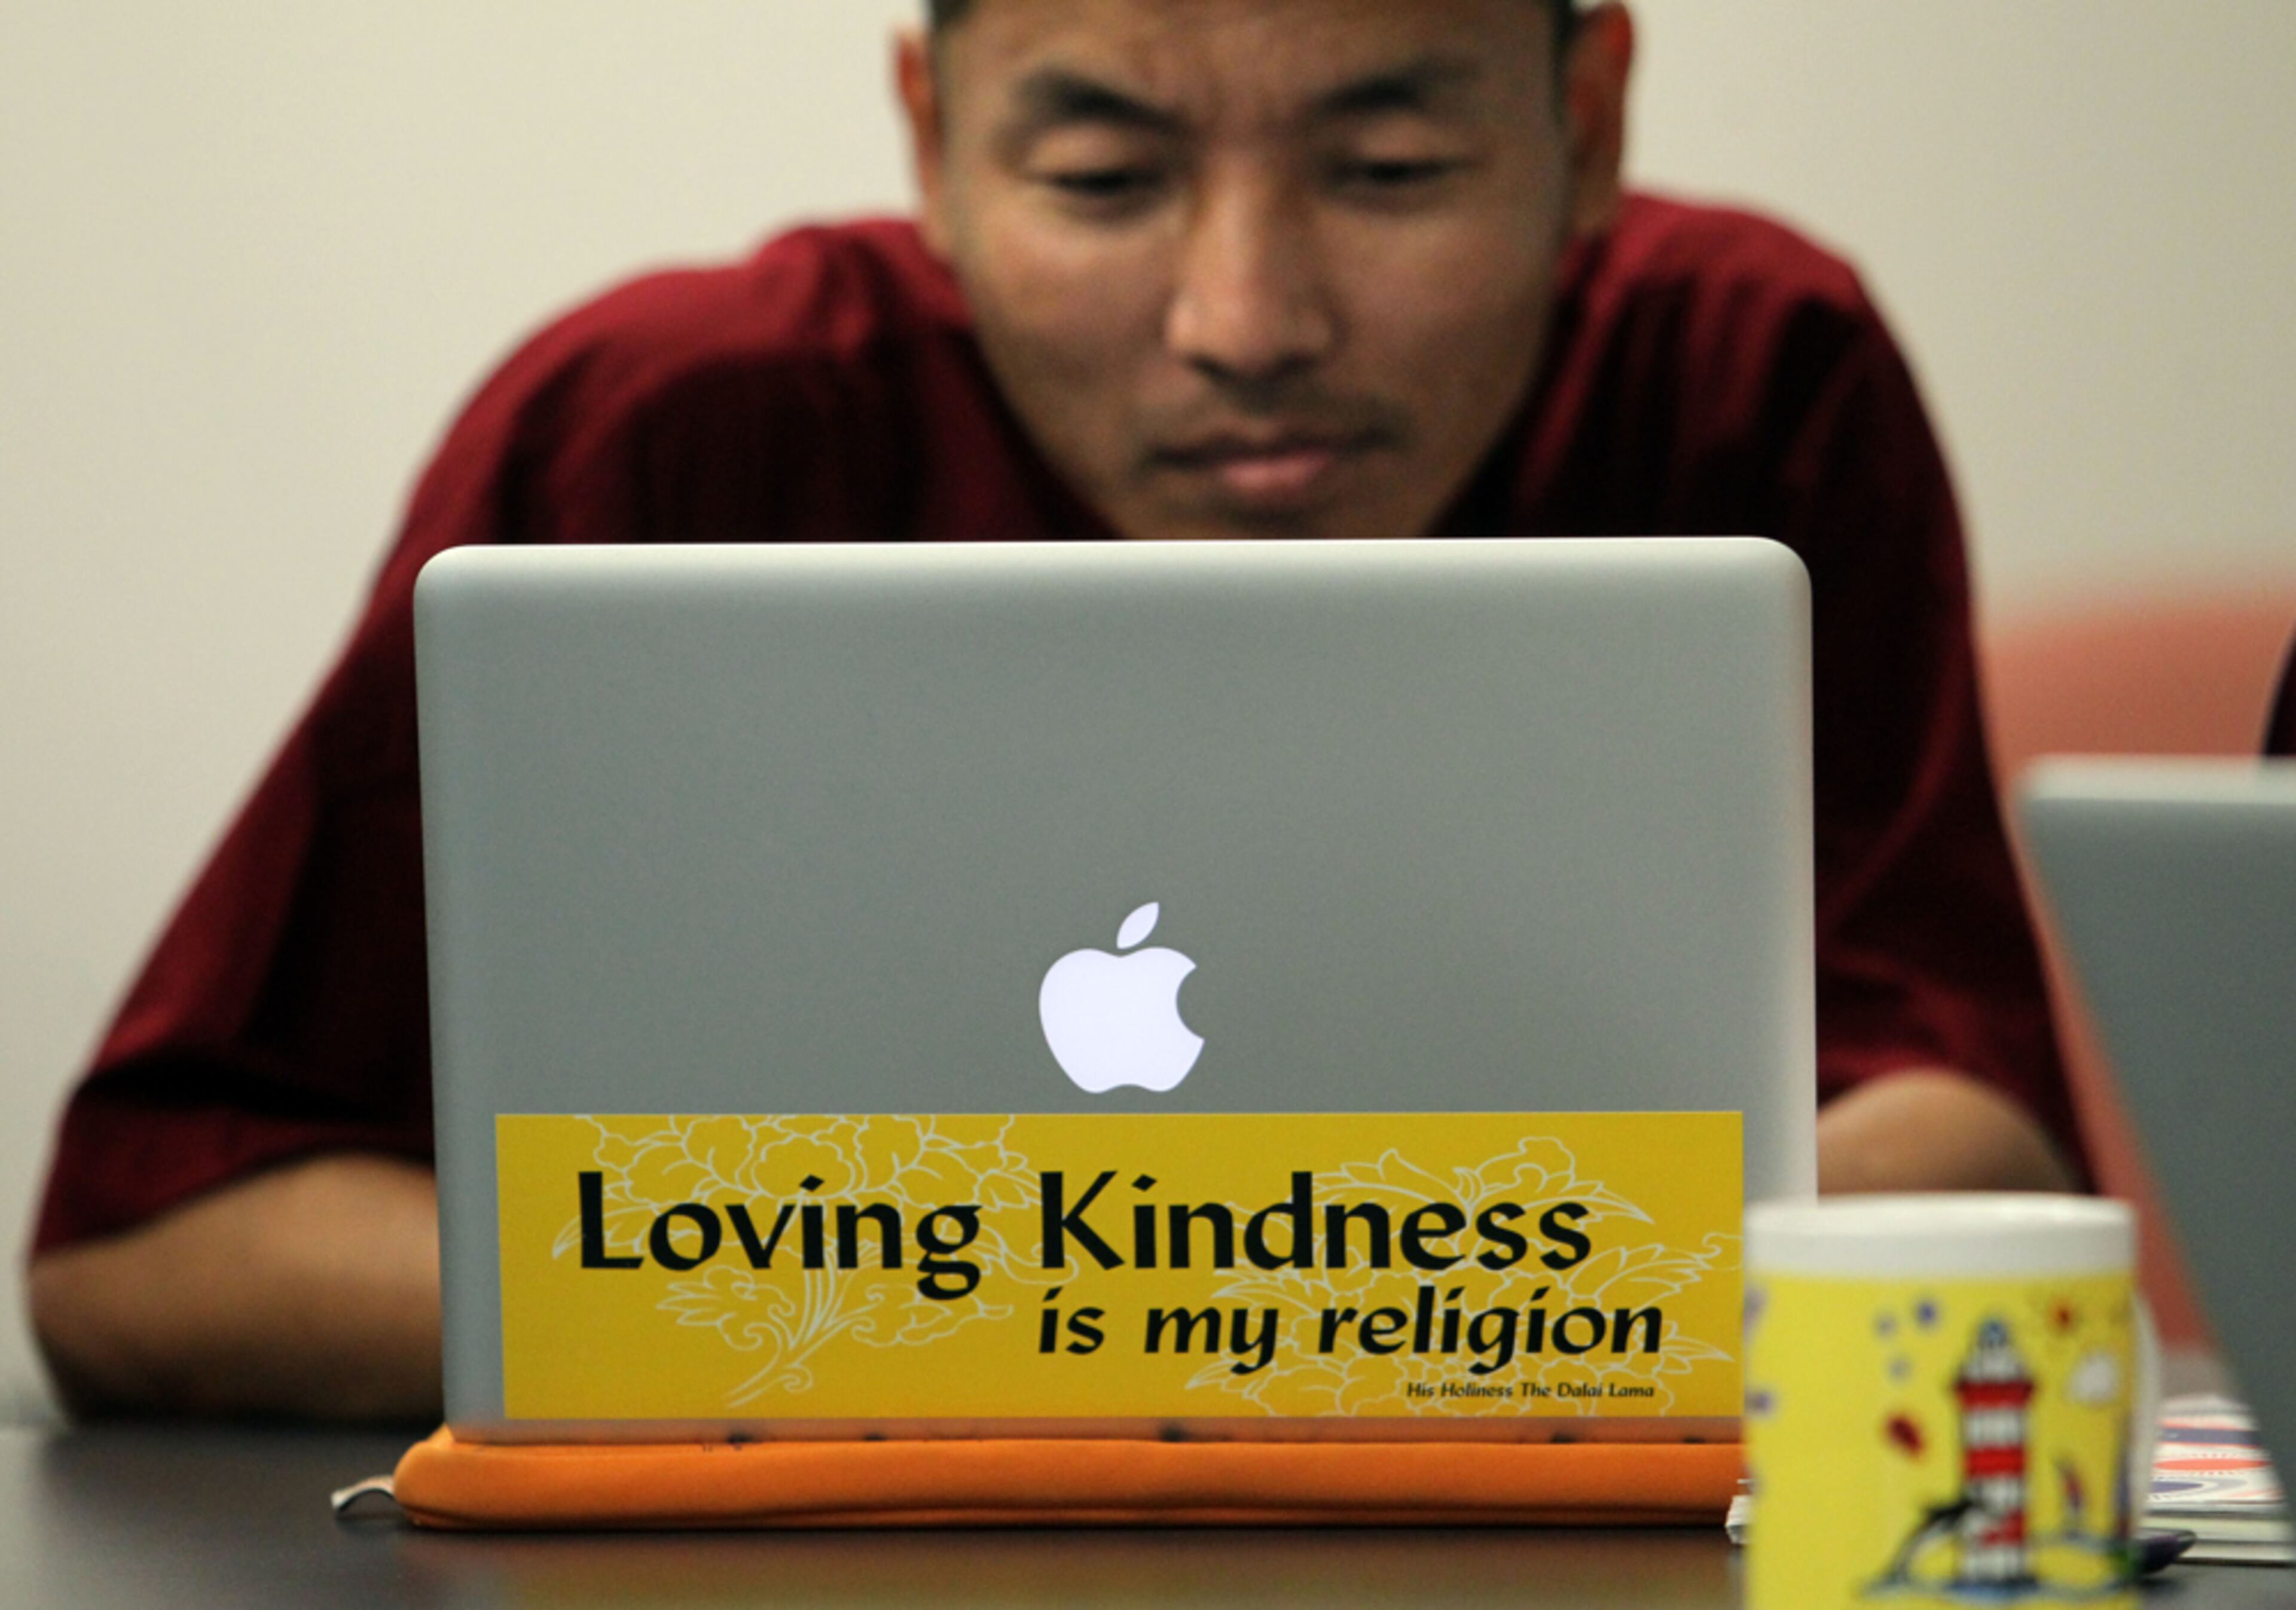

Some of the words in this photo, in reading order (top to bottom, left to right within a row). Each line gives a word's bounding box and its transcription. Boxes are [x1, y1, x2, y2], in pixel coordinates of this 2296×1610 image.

[578, 1170, 982, 1301] Loving
[1039, 1170, 1592, 1271] Kindness
[1038, 1285, 1106, 1356] is
[1144, 1306, 1280, 1376] my
[1318, 1285, 1663, 1376] religion
[1406, 1383, 1434, 1397] His
[1440, 1382, 1513, 1397] Holiness
[1521, 1382, 1552, 1397] The
[1557, 1382, 1603, 1397] Dalai
[1608, 1383, 1654, 1397] Lama
